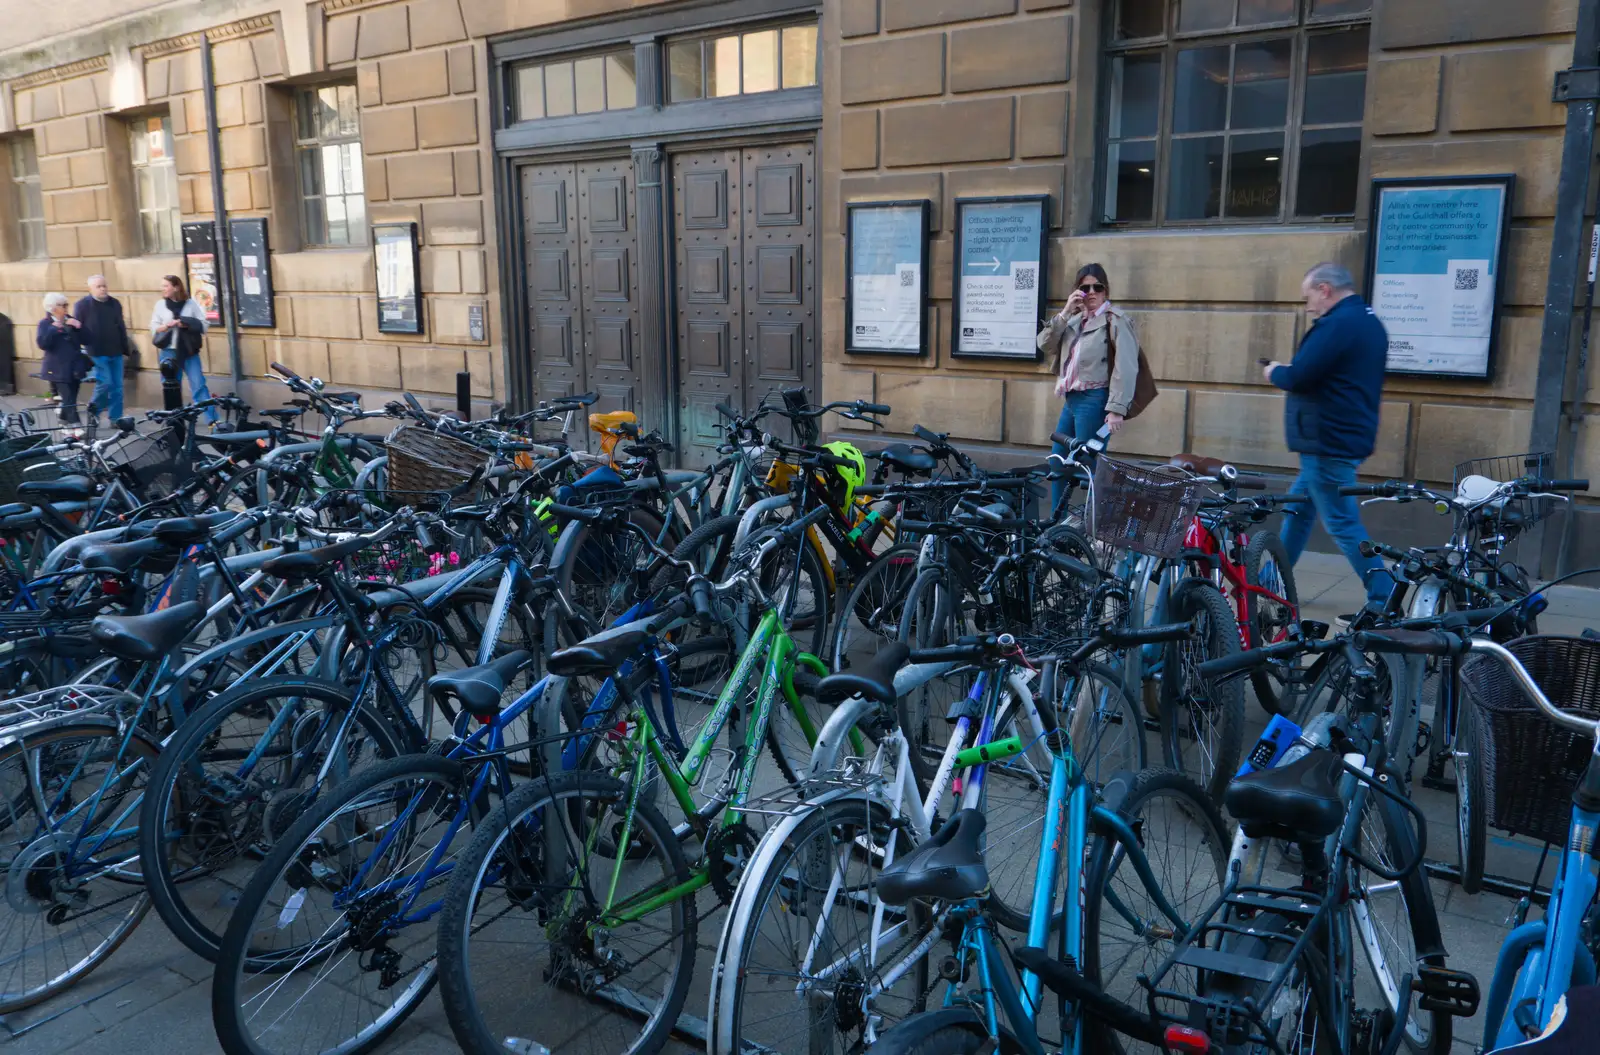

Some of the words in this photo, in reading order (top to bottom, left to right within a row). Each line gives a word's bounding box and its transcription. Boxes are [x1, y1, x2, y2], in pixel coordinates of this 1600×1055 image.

[1460, 200, 1478, 208] here
[1413, 211, 1448, 219] Guildhall
[992, 225, 1031, 233] co-working
[1430, 222, 1474, 230] community
[974, 236, 989, 244] right
[825, 518, 845, 542] GAZELLE
